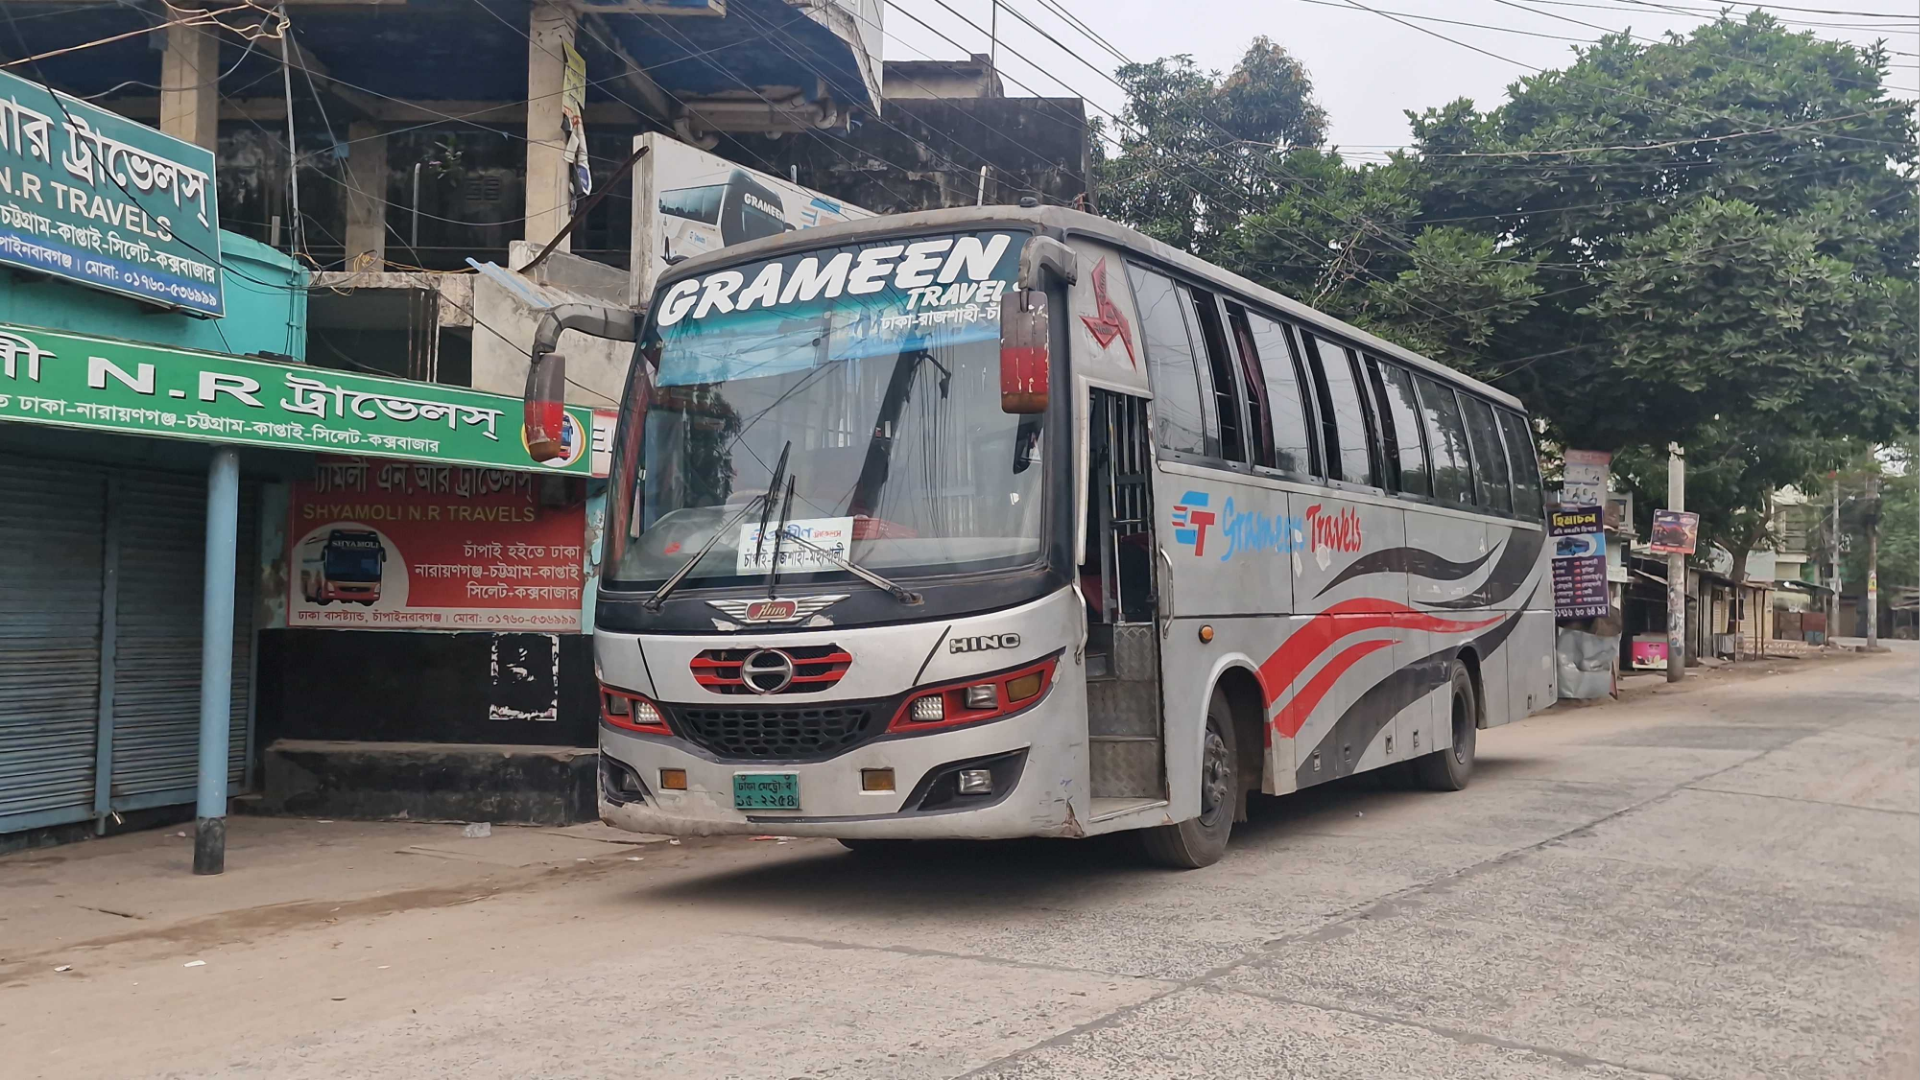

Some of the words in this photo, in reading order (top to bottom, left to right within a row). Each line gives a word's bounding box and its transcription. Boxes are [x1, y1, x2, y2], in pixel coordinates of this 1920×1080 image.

[61, 105, 209, 228] ট্রাভেলস্
[51, 181, 173, 242] TRAVELS
[744, 192, 785, 222] GRAMEEN
[657, 233, 1011, 327] GRAMEEN
[906, 280, 1021, 310] TRAVEL
[880, 301, 1000, 331] ঢাকা-রাজশাহী-চাঁ
[88, 356, 264, 408] N.R
[280, 372, 504, 441] ট্রাভেলস্
[303, 504, 401, 520] SHYAMOLI
[408, 505, 441, 521] N.R
[446, 506, 536, 522] TRAVELS
[1306, 503, 1362, 553] Travels
[331, 540, 379, 549] SHYAMOLI
[463, 540, 503, 560] চাঁপাই
[507, 541, 546, 560] হইতে
[549, 544, 581, 560] ঢাকা
[298, 611, 320, 621] ঢাকা
[756, 602, 787, 619] Hino
[950, 632, 1020, 654] HINO
[738, 782, 756, 791] ঢাকা
